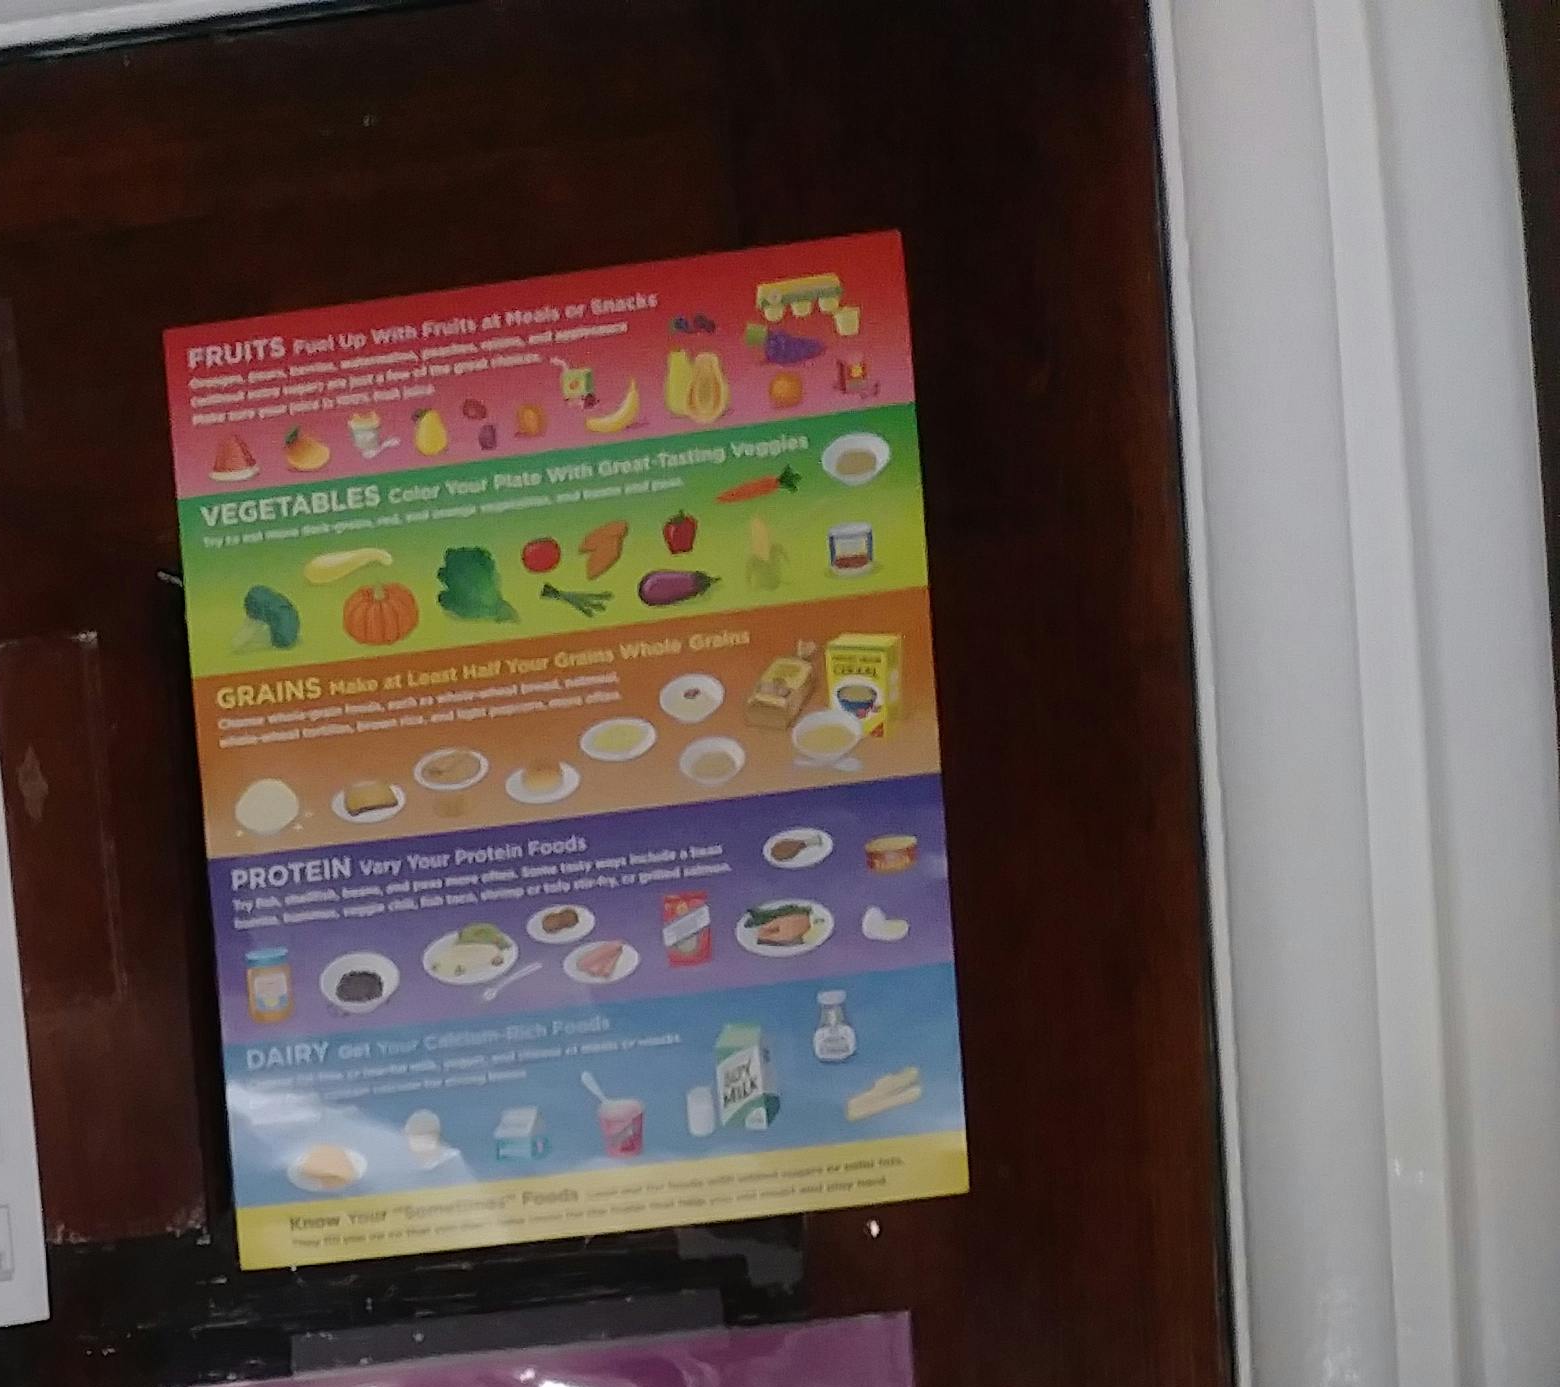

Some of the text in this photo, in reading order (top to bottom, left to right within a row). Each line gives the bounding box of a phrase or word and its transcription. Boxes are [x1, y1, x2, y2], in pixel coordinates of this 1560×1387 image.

[189, 336, 285, 368] FRUITS
[293, 335, 335, 355] Fuel
[339, 332, 366, 349] Up
[371, 325, 417, 344] With
[422, 317, 476, 338] Fruits
[481, 313, 501, 330] at
[565, 304, 585, 319] or
[200, 485, 380, 526] VEGETABLES
[389, 484, 440, 504] Color
[445, 479, 488, 495] Your
[493, 472, 541, 491] Plate
[546, 464, 592, 484] With
[731, 434, 809, 458] Veggies
[216, 677, 322, 709] GRAINS
[330, 677, 378, 695] Make
[383, 674, 402, 690] at
[407, 666, 458, 687] Least
[462, 660, 502, 679] Half
[505, 657, 549, 674] Your
[620, 639, 682, 660] Whole
[689, 630, 751, 650] Grains
[231, 834, 586, 891] PROTEIN Vary Your Protein Foods
[247, 1040, 329, 1072] DAIRY
[551, 1014, 610, 1036] Foods
[723, 1077, 760, 1107] MILK
[724, 1062, 752, 1087] SOY
